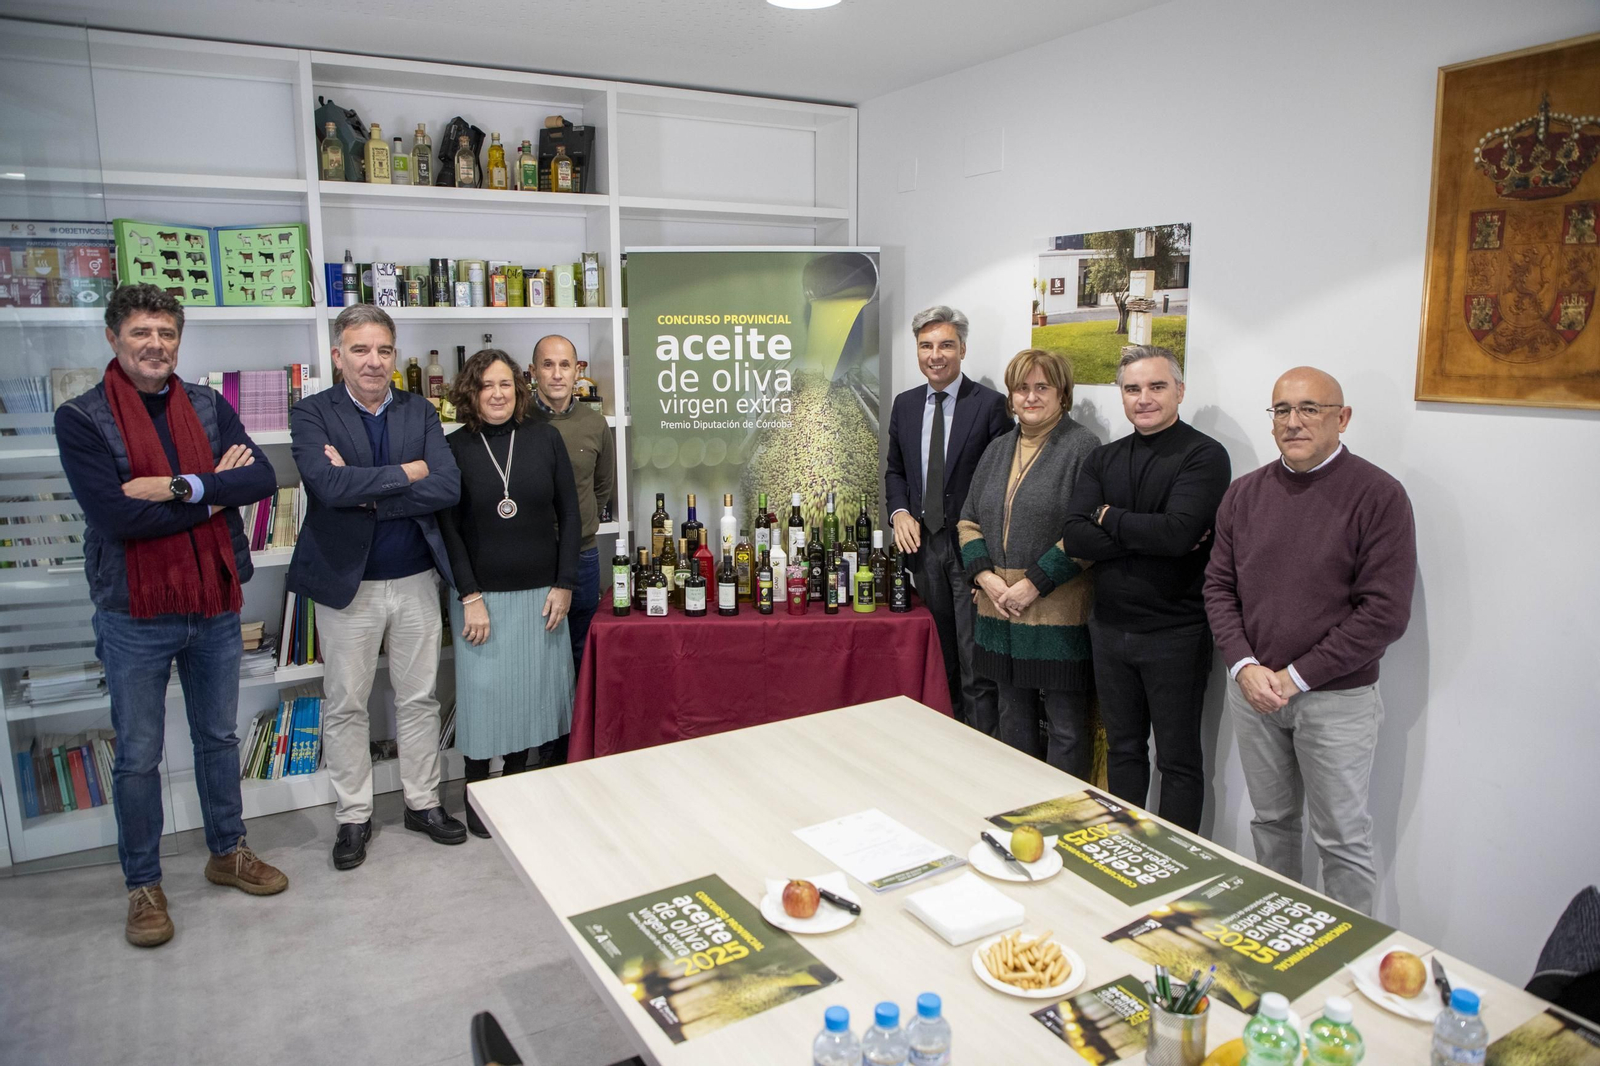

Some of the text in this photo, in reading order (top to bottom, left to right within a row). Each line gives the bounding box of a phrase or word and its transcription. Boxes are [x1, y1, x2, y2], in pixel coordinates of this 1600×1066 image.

[58, 227, 101, 235] OBJETIVOS
[657, 314, 792, 325] CONCURSO PROVINCIAL
[656, 326, 792, 361] aceite
[658, 362, 792, 393] de oliva
[660, 394, 792, 418] virgen extra
[660, 420, 792, 430] Premio Diputación de Córdoba
[1063, 824, 1119, 846] 2025
[1098, 838, 1143, 864] oliva
[1057, 840, 1138, 888] CONCURSO PROVINCIA
[1082, 843, 1156, 885] aceite
[1112, 835, 1180, 874] virgen extra
[1143, 863, 1171, 879] de
[672, 894, 732, 944] aceite
[695, 890, 730, 920] CONCURSO
[1230, 896, 1294, 932] virgen extra
[1245, 902, 1312, 941] de oliva
[638, 907, 668, 934] virgen
[662, 931, 691, 957] extra
[652, 902, 678, 920] de
[670, 919, 710, 952] oliva
[1202, 924, 1280, 964] 2025
[1267, 911, 1337, 952] aceite
[674, 940, 750, 976] 2025
[1272, 922, 1352, 972] CONCURSO PROVINCIAL
